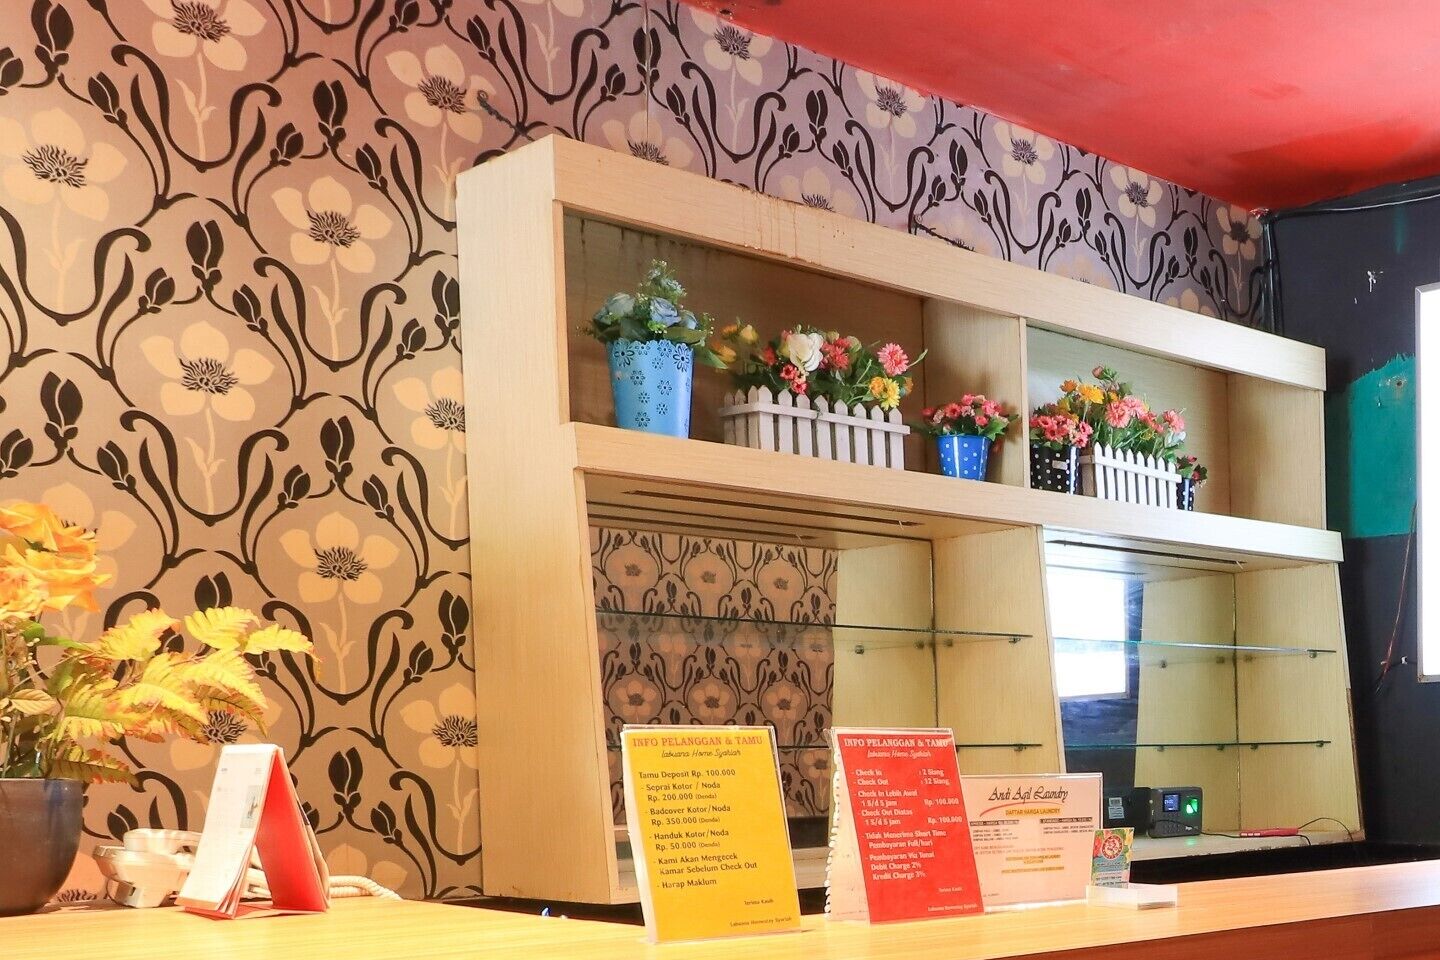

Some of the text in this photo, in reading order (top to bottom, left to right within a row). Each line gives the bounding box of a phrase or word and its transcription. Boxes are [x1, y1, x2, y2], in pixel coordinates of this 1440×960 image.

[633, 736, 763, 747] INFO PELANGGAN & TAMU
[844, 738, 864, 747] INFO
[867, 738, 915, 747] PELANGGAN
[926, 738, 949, 747] TAMU
[639, 771, 659, 779] Tamu
[661, 769, 689, 779] Deposit
[855, 768, 874, 776] Check
[672, 782, 692, 790] Kotor
[702, 781, 720, 789] Noda
[662, 793, 693, 801] 200.000
[1033, 785, 1069, 803] Laundry
[650, 806, 684, 815] Badcover
[654, 831, 683, 840] Handuk
[670, 842, 697, 850] 50.000
[658, 852, 738, 865] Kami Akan Mengecek
[660, 861, 758, 875] Kamar Sebelum Check Out
[662, 878, 717, 889] Harap Maklum
